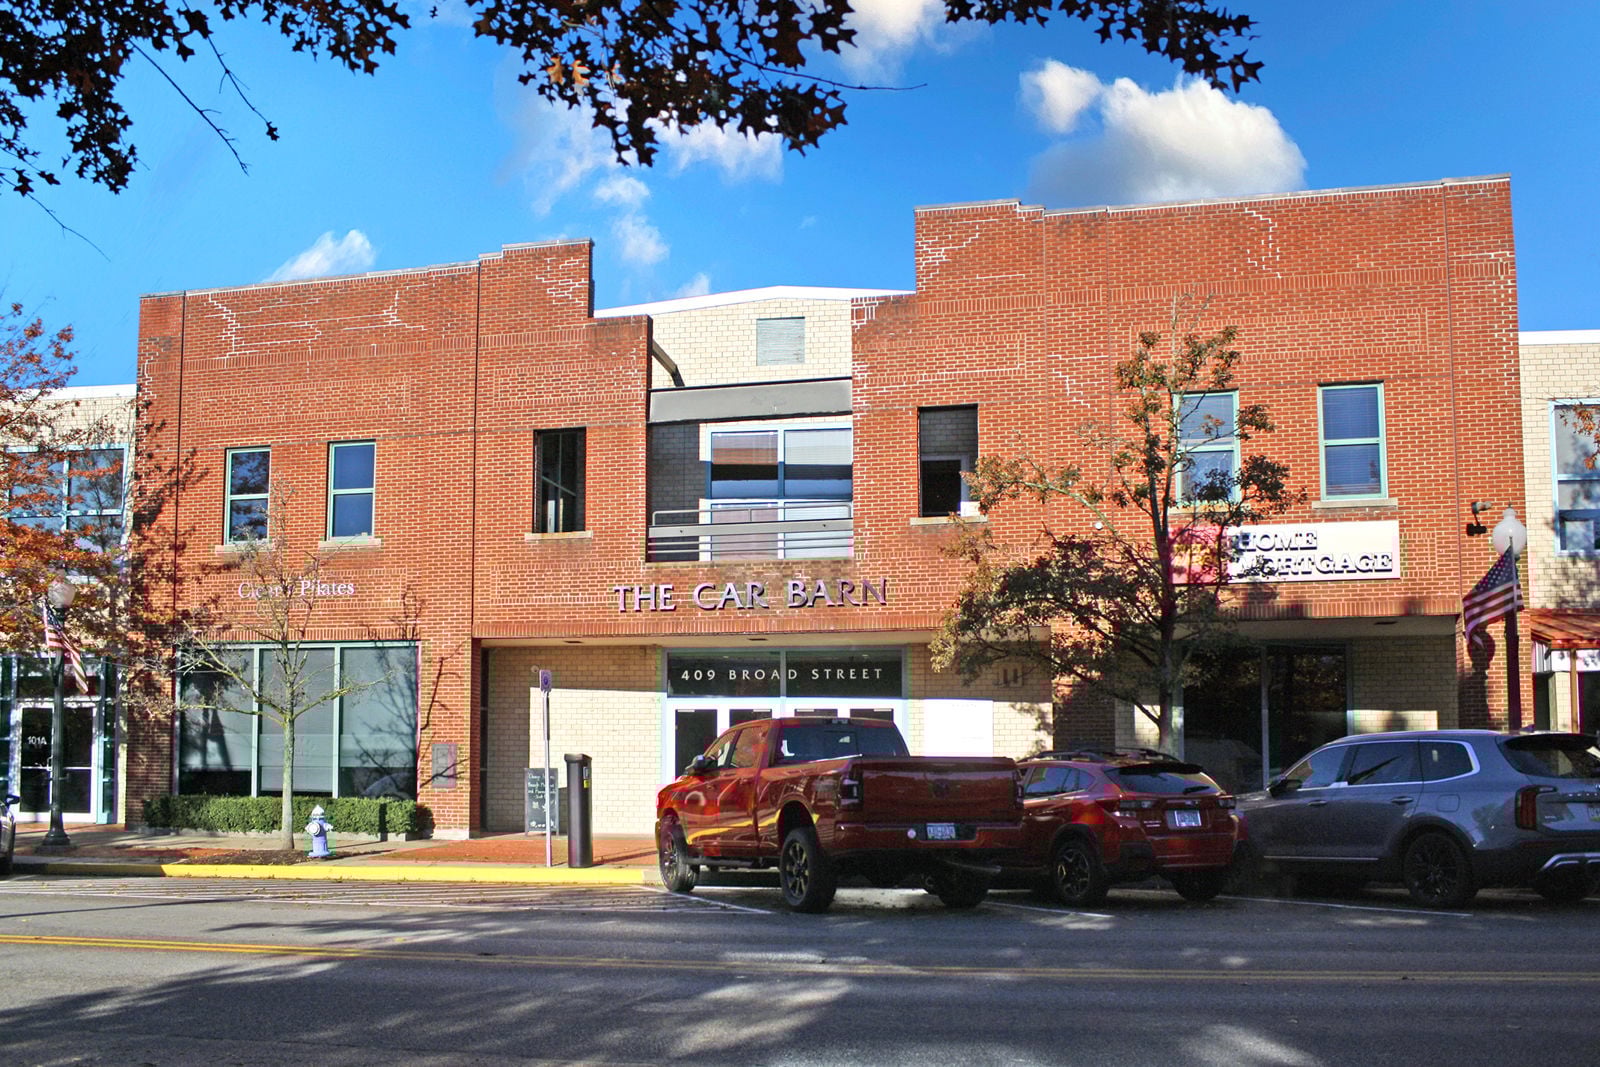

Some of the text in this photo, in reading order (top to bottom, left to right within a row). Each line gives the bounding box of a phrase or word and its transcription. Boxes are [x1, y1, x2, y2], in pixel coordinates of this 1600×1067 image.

[1233, 531, 1318, 552] HOME
[1236, 552, 1393, 577] MORTGAGE
[614, 578, 887, 612] THE CAR BARN
[681, 668, 883, 681] 409 BROAD STREET
